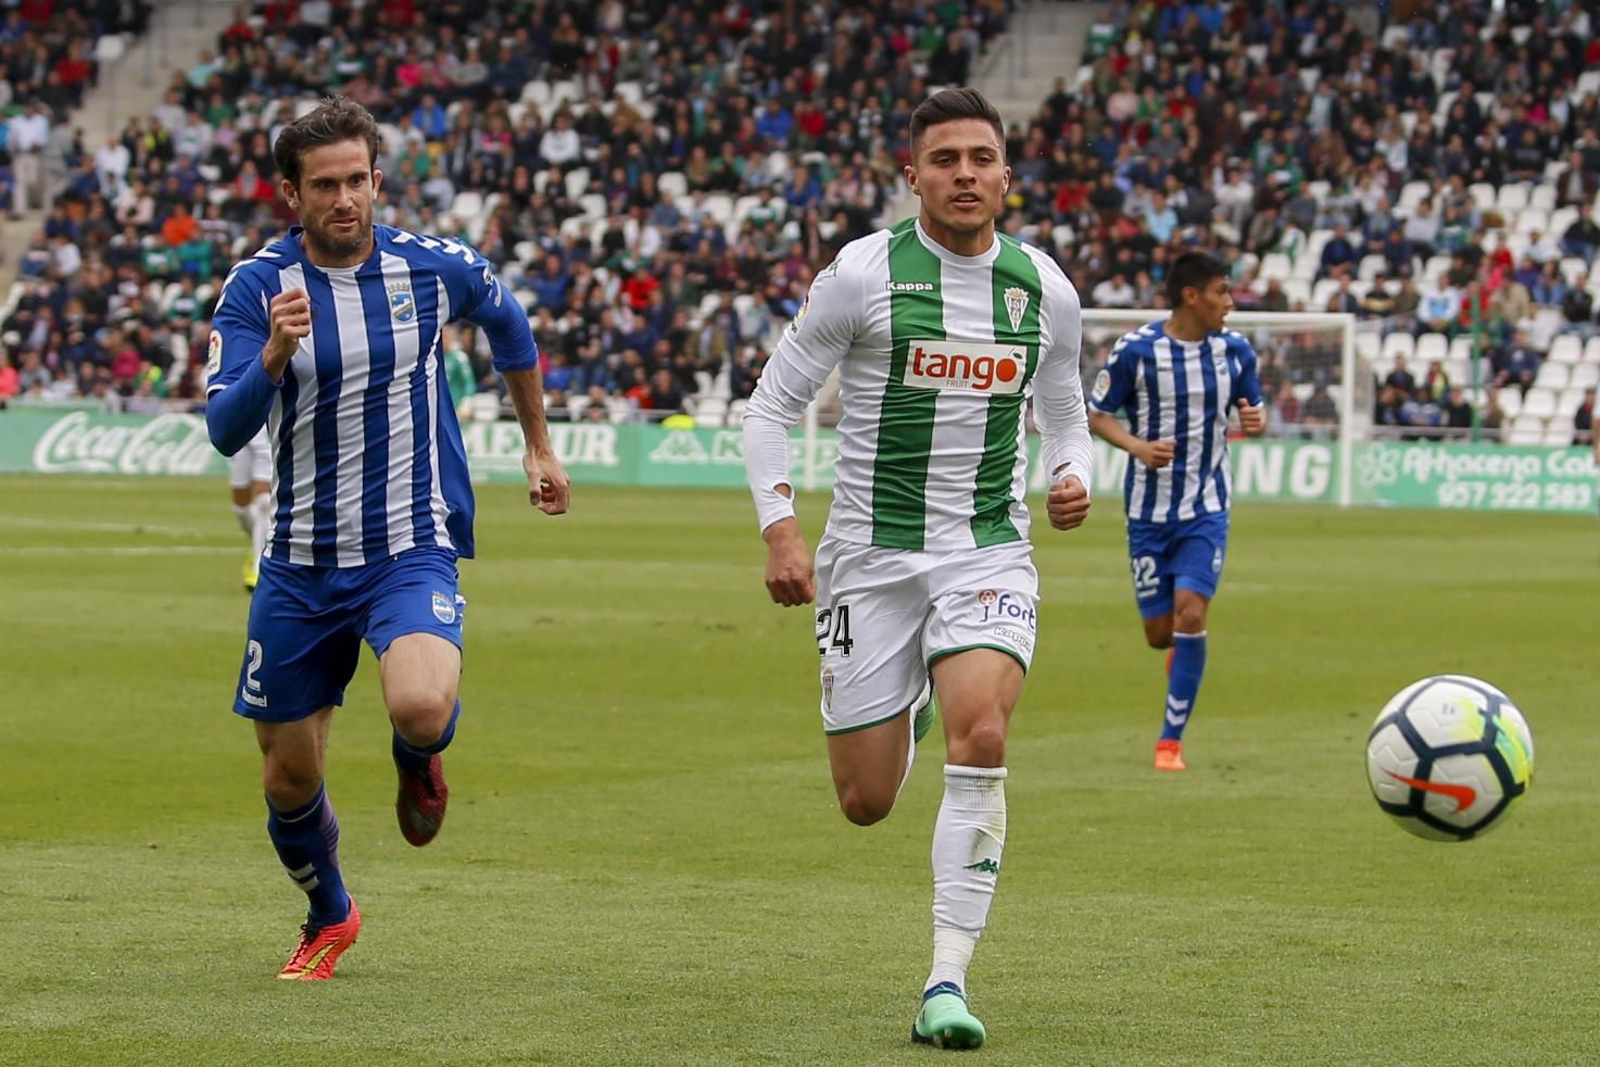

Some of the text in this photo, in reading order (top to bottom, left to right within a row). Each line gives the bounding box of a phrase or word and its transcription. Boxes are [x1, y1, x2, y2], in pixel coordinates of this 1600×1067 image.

[886, 281, 934, 292] Kappa
[913, 347, 1018, 390] tango
[946, 379, 969, 389] FRUIT
[1132, 556, 1161, 589] 22
[816, 603, 854, 658] 24
[248, 639, 264, 692] 2
